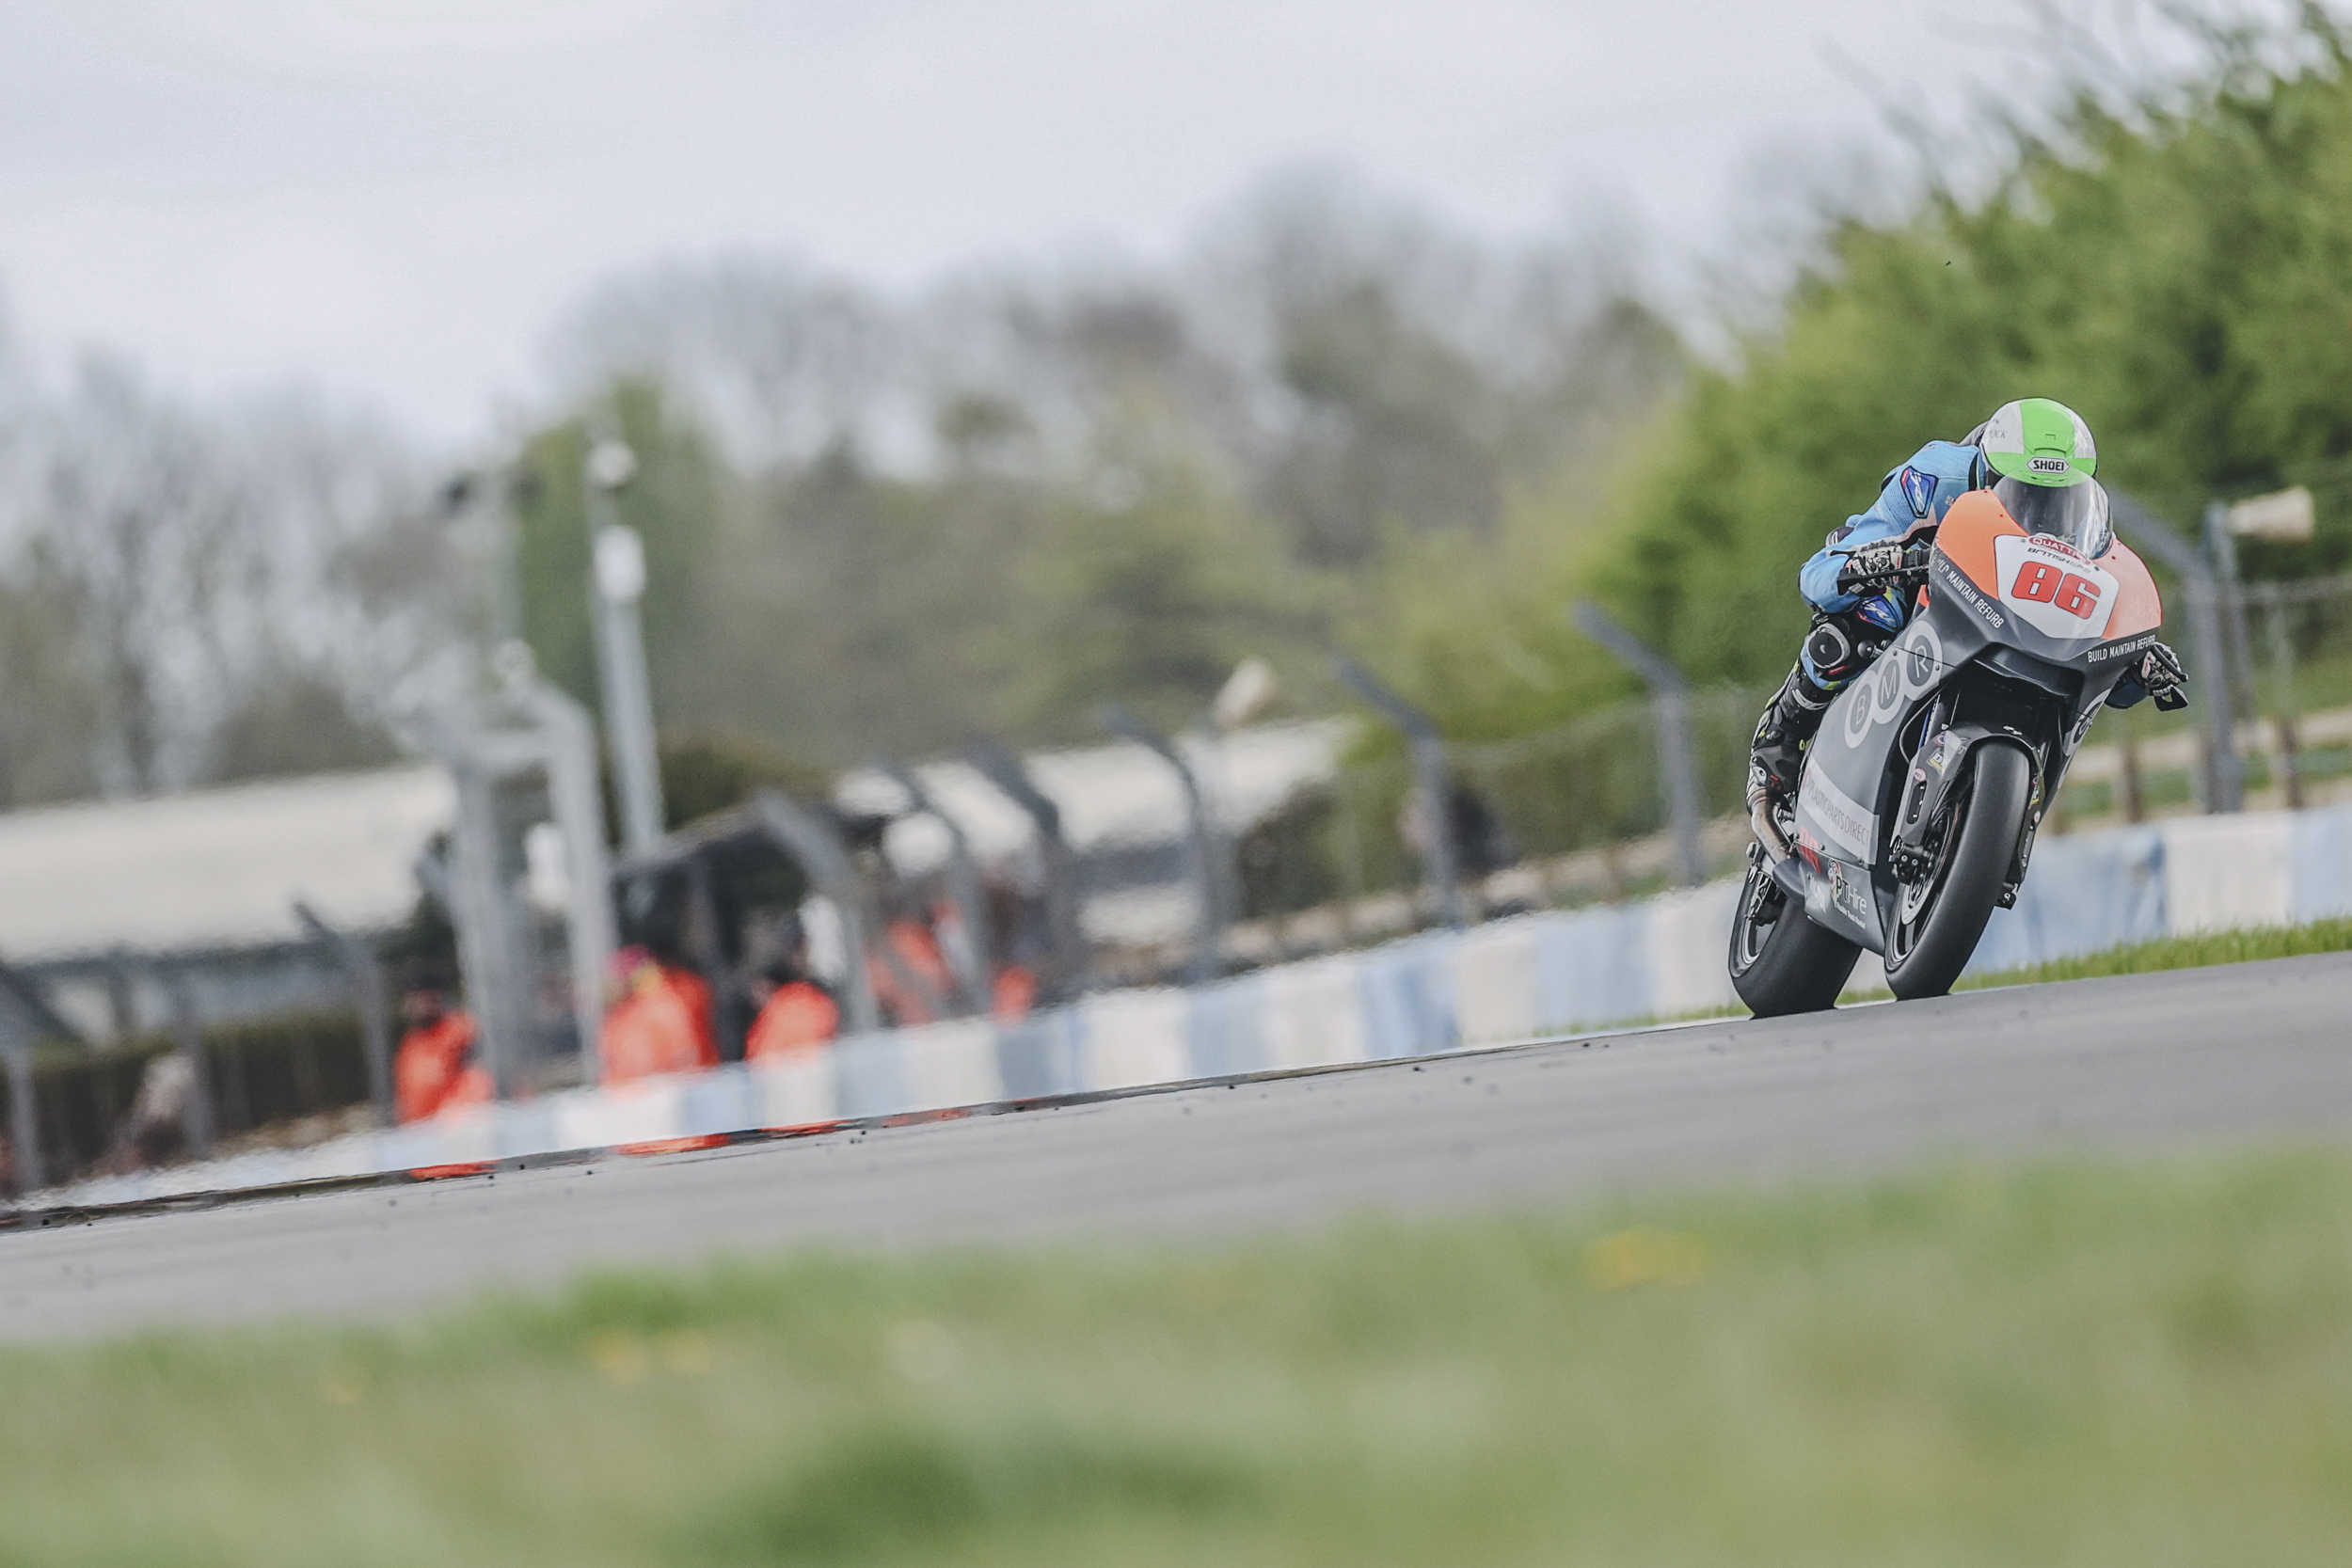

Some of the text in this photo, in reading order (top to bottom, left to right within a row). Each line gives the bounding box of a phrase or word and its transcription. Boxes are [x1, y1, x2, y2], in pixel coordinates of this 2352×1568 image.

[2033, 459, 2065, 471] SHOEI
[1946, 570, 1979, 604] MAINTAIN
[1974, 598, 2005, 628] REFURB
[2011, 561, 2101, 620] 86
[2088, 648, 2107, 663] BUILD
[2109, 641, 2137, 658] MAINTAIN
